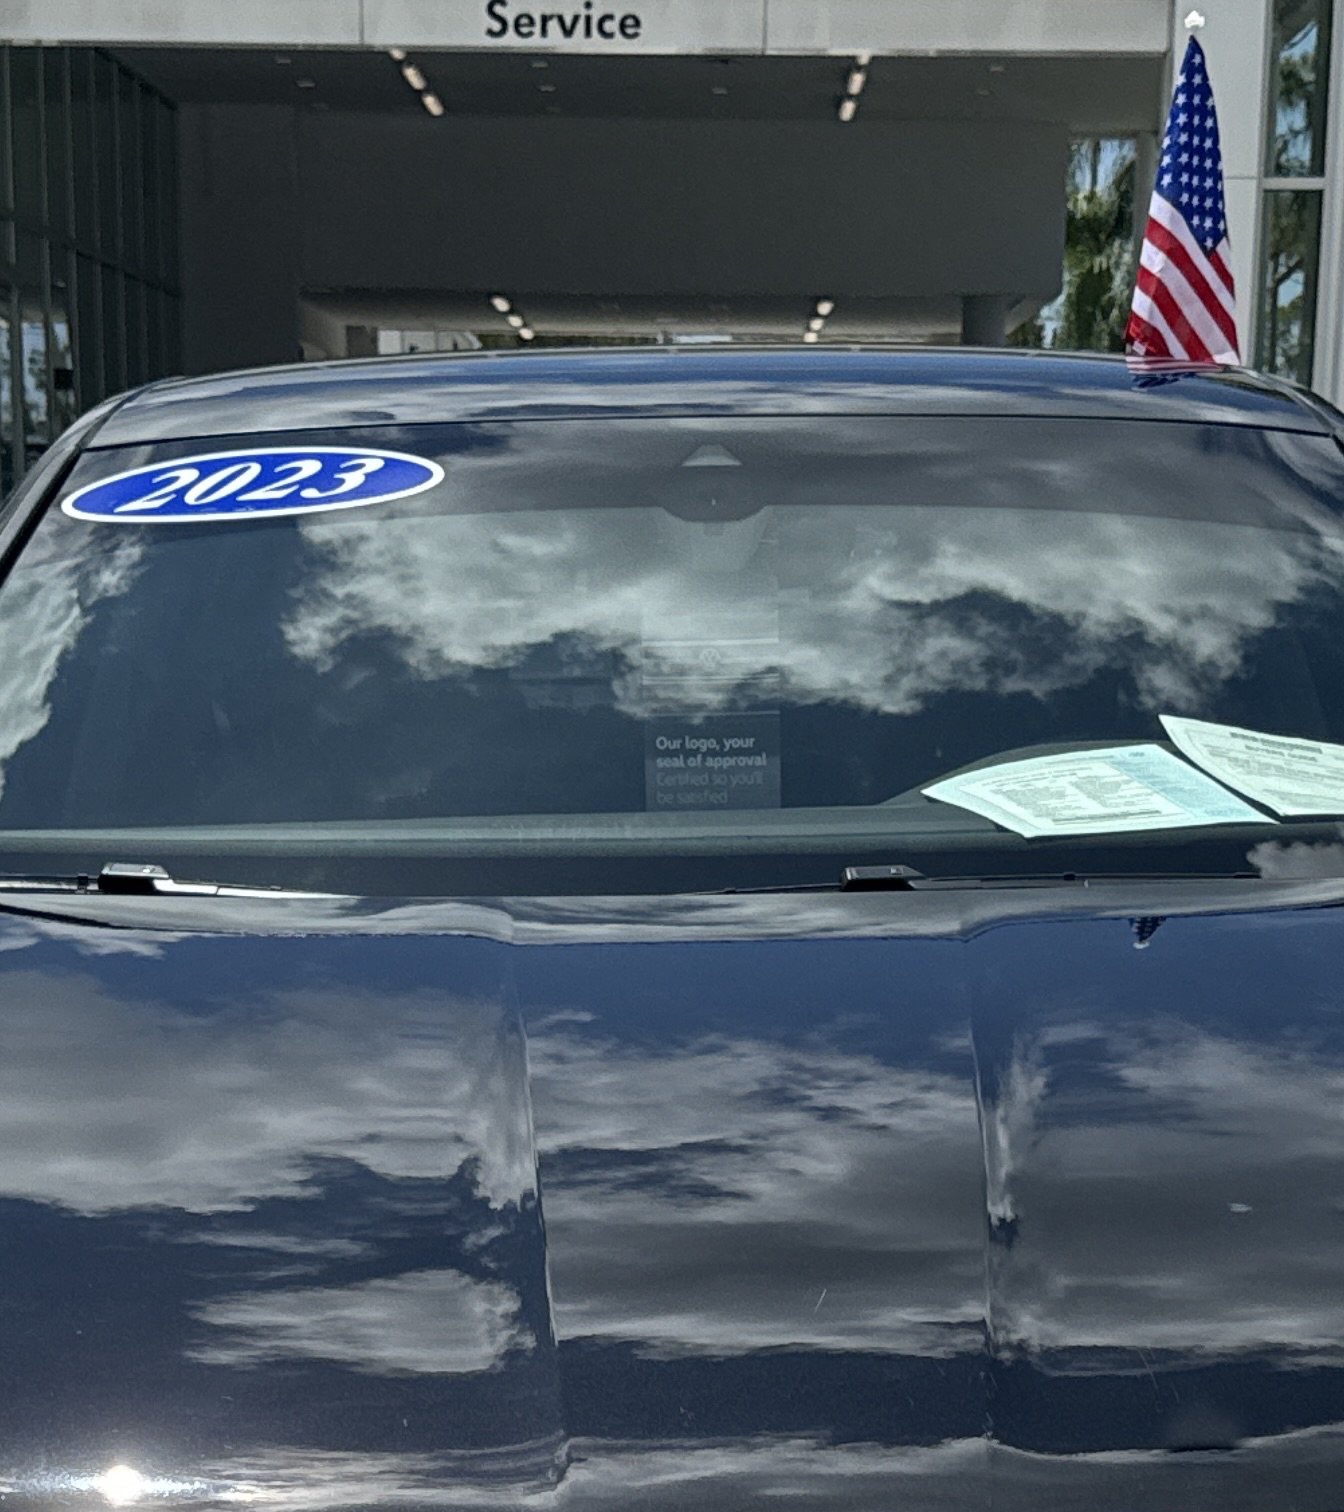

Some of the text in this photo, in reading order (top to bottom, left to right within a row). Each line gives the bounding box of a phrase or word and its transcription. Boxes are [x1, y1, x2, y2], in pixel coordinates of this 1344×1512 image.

[485, 0, 642, 40] Service
[113, 457, 386, 514] 2023
[656, 735, 755, 752] Our logo, your
[656, 752, 767, 770] seal of approval
[713, 774, 728, 786] so
